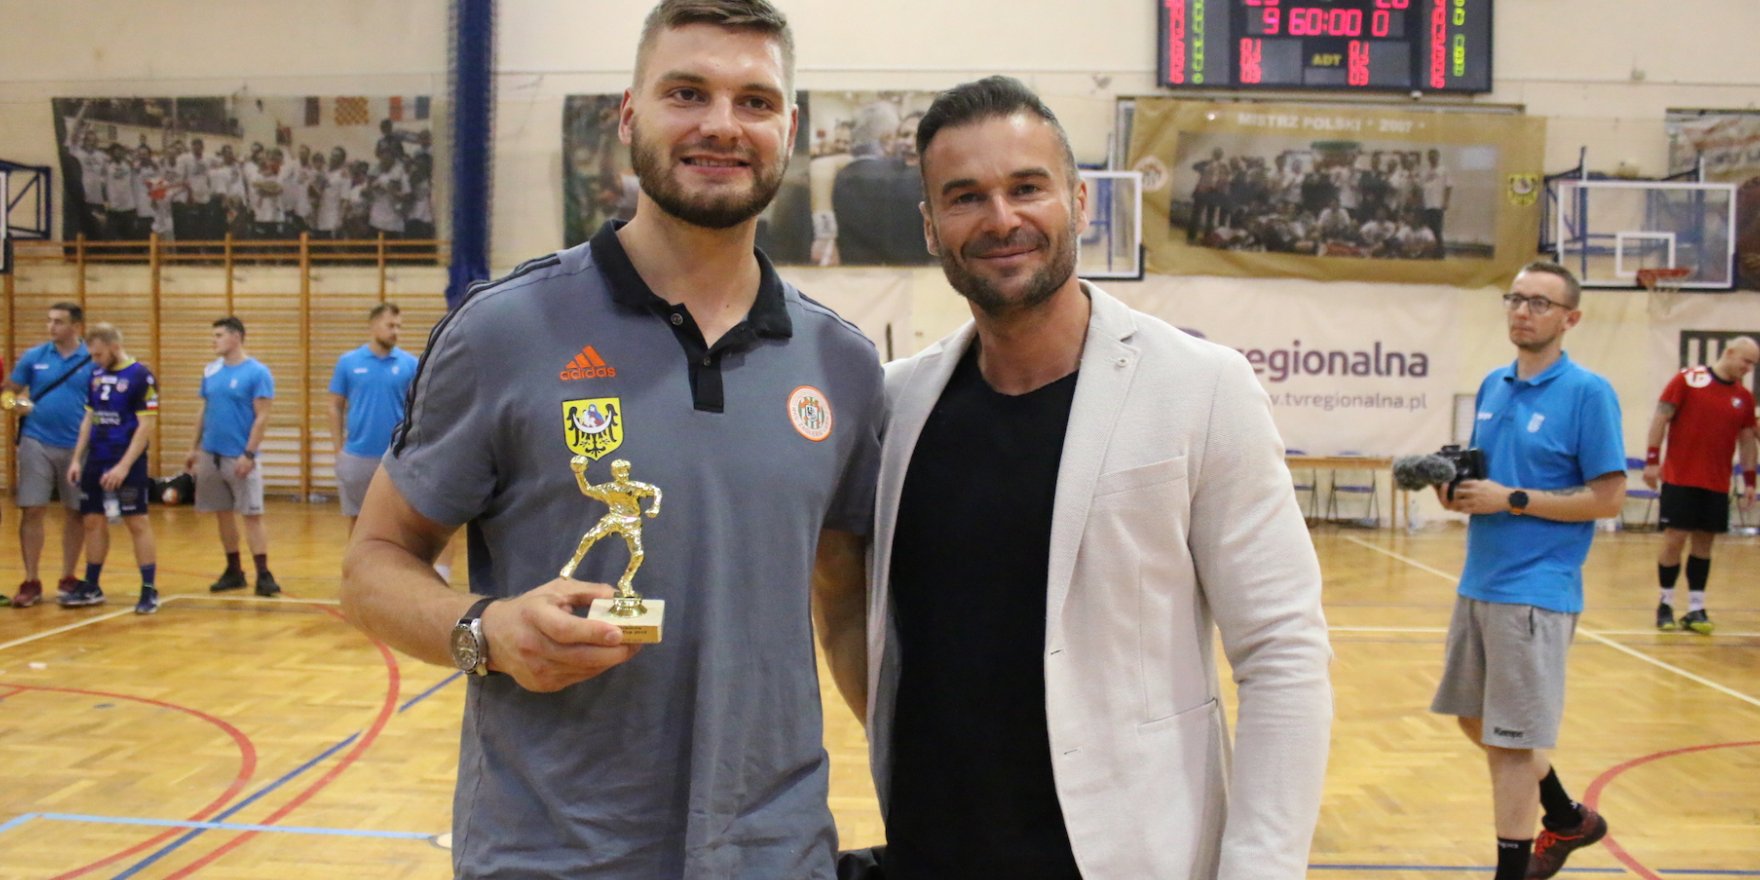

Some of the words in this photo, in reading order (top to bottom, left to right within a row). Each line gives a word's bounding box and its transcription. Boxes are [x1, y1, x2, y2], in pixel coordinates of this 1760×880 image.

[1263, 7, 1280, 35] 9
[1289, 8, 1362, 36] 60:00
[1372, 10, 1389, 37] 0
[1237, 112, 1299, 128] MISTRZ
[1302, 116, 1361, 131] POLSKI
[1235, 340, 1428, 382] egionalna
[560, 366, 617, 381] adidas
[101, 385, 111, 400] 2
